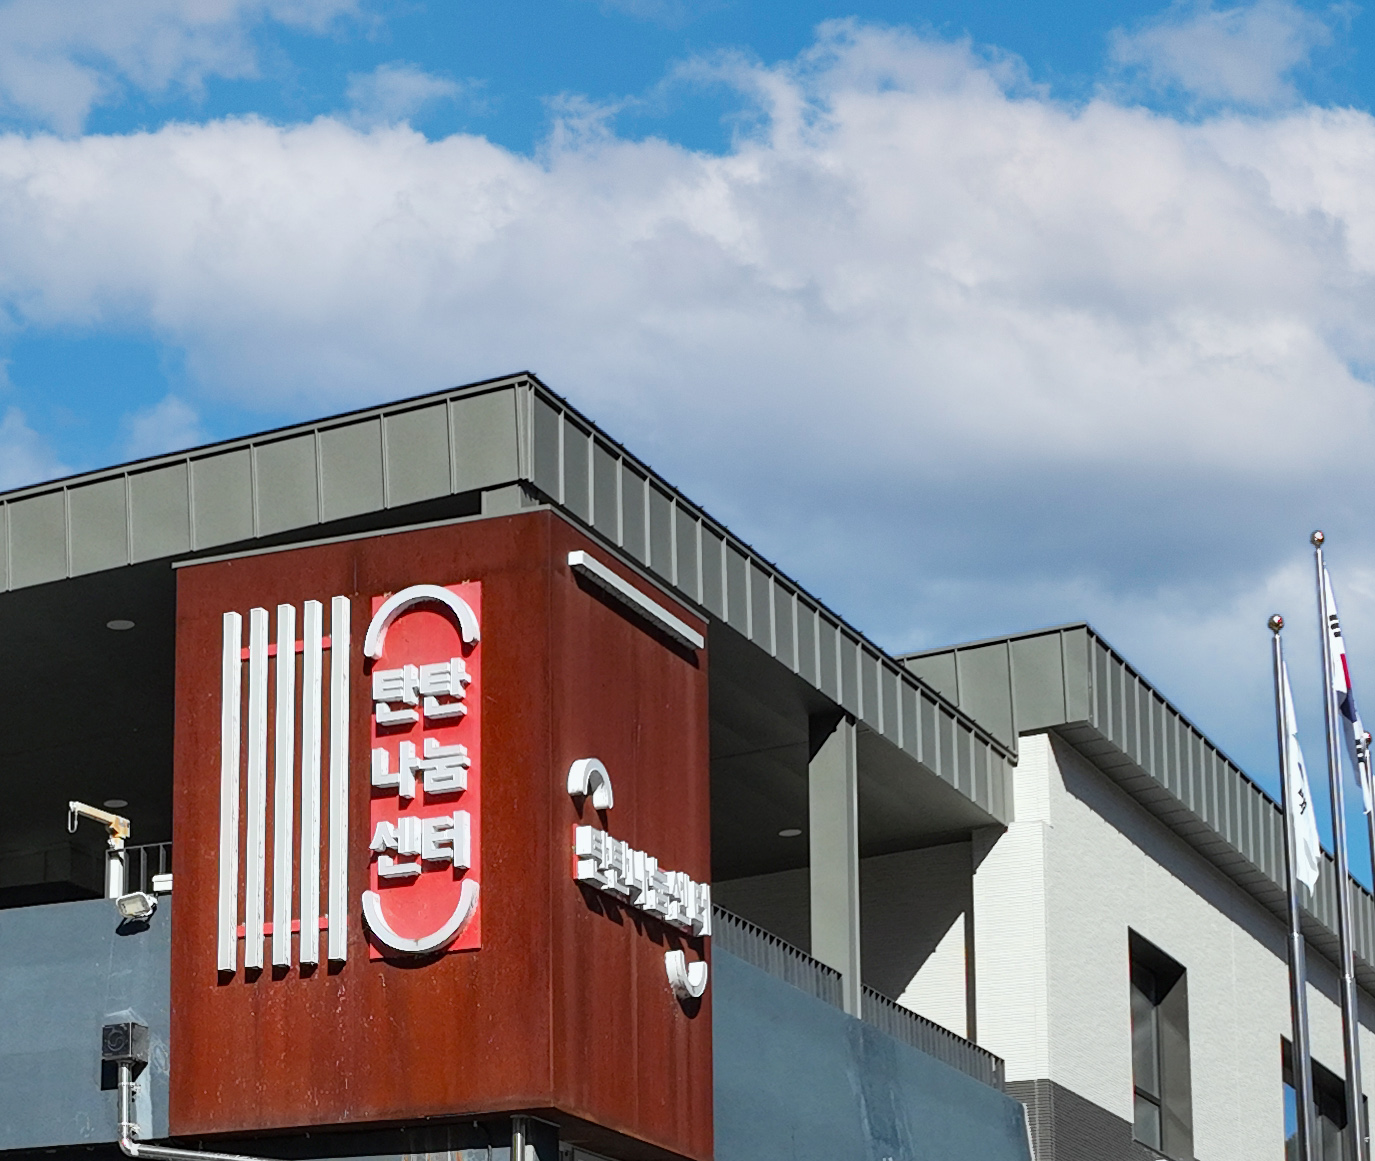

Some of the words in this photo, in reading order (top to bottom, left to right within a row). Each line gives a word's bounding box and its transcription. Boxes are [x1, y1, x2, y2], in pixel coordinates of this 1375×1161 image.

[372, 657, 472, 726] 탄탄
[371, 737, 471, 799] 나눔
[369, 810, 471, 878] 센터
